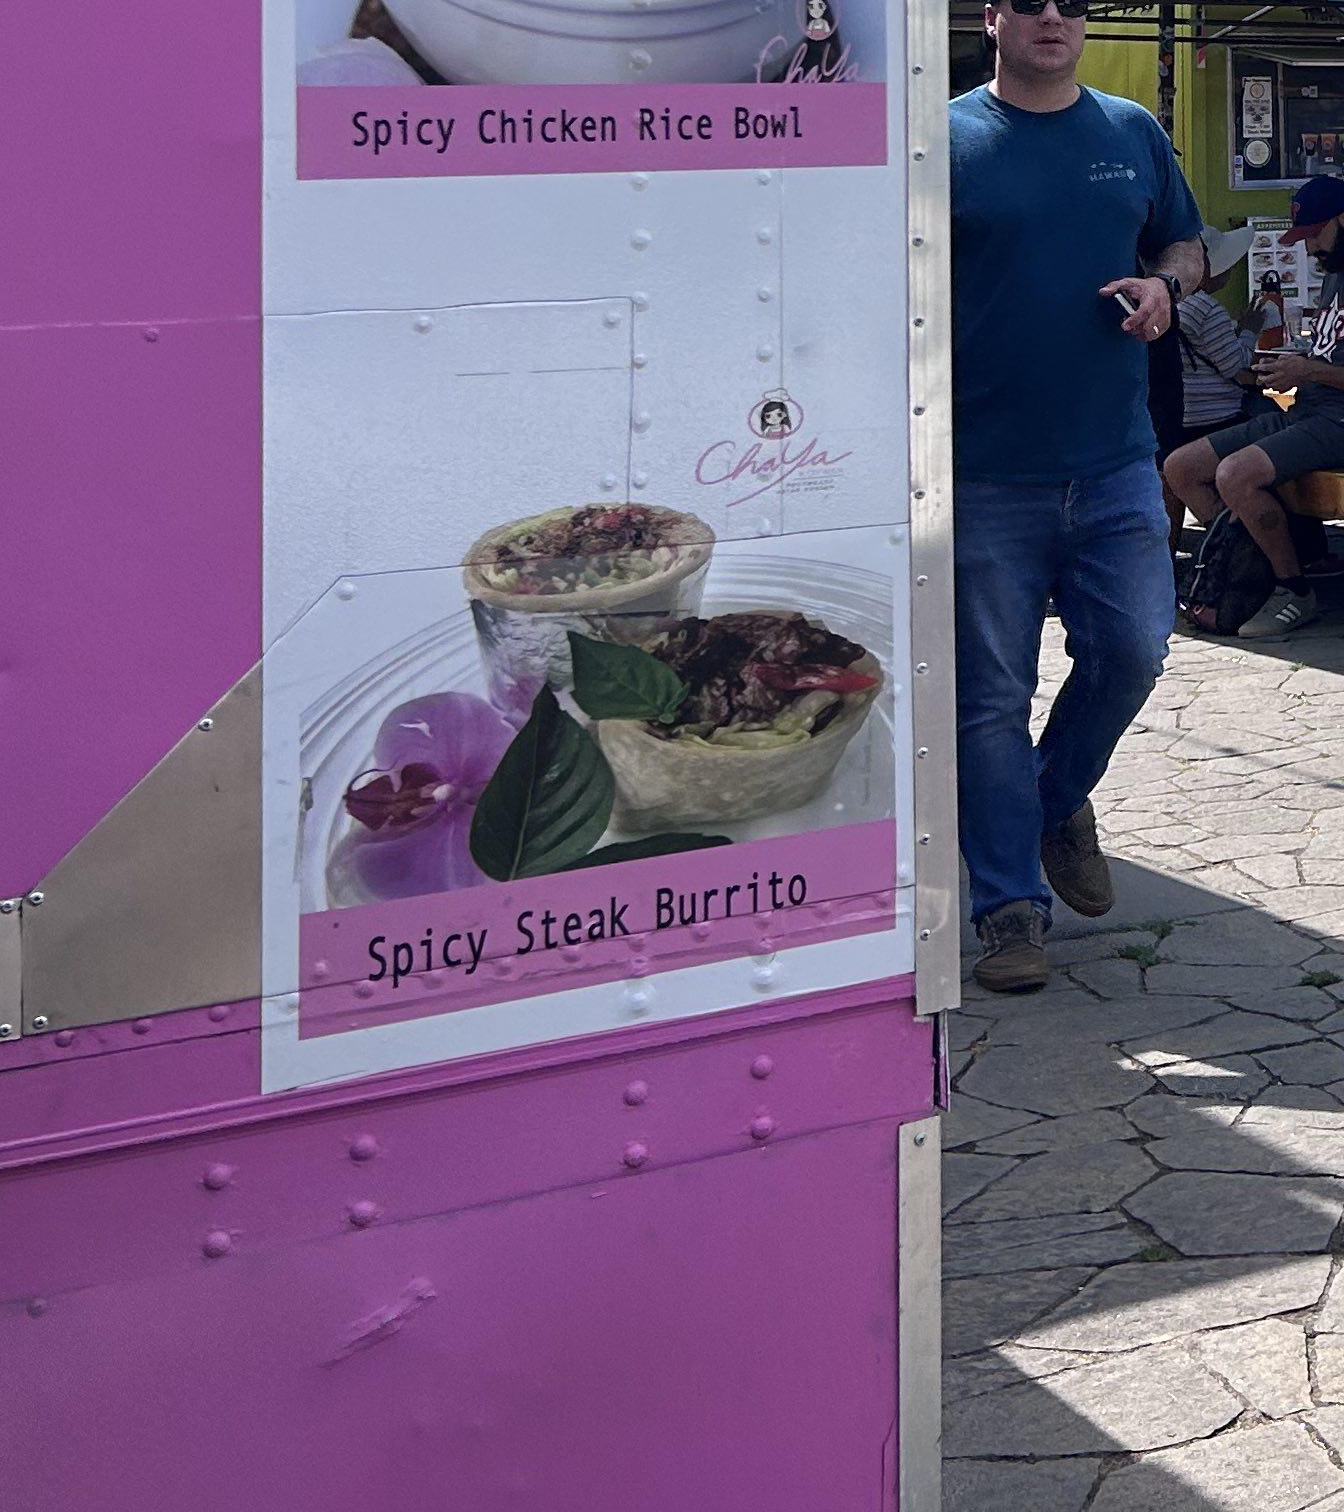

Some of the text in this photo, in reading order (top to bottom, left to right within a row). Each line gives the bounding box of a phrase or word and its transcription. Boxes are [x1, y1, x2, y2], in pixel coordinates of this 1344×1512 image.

[351, 106, 804, 155] Spicy Chicken Rice Bowl
[368, 871, 808, 988] Spicy Steak Burrito
